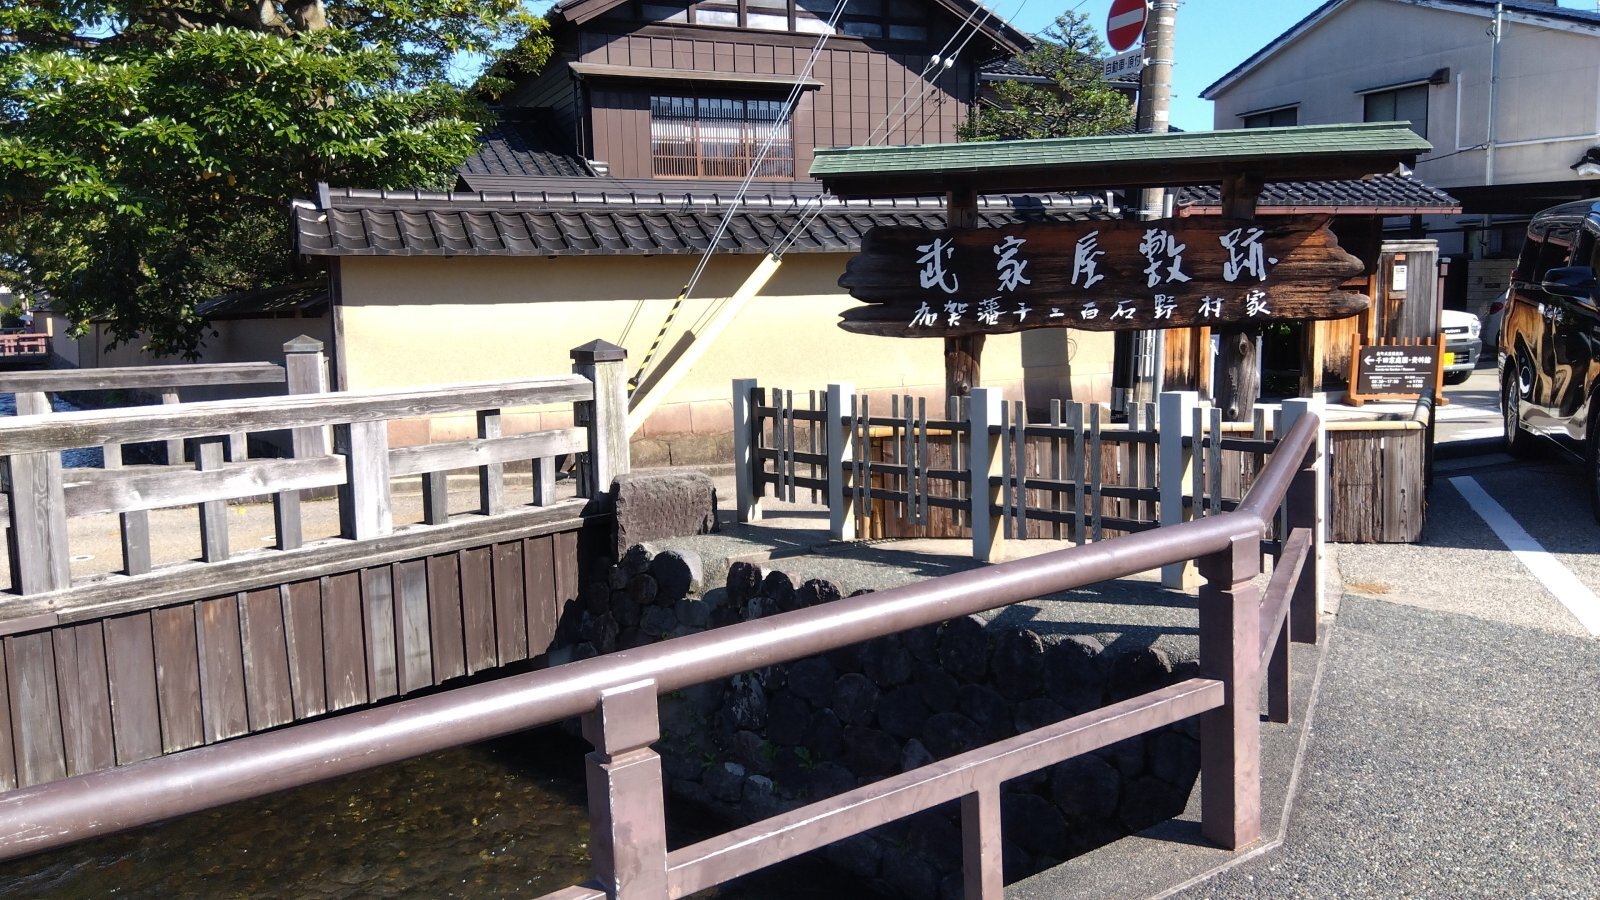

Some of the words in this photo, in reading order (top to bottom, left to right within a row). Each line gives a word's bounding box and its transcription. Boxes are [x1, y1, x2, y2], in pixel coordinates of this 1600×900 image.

[916, 228, 1278, 293] 武家屋敷跡
